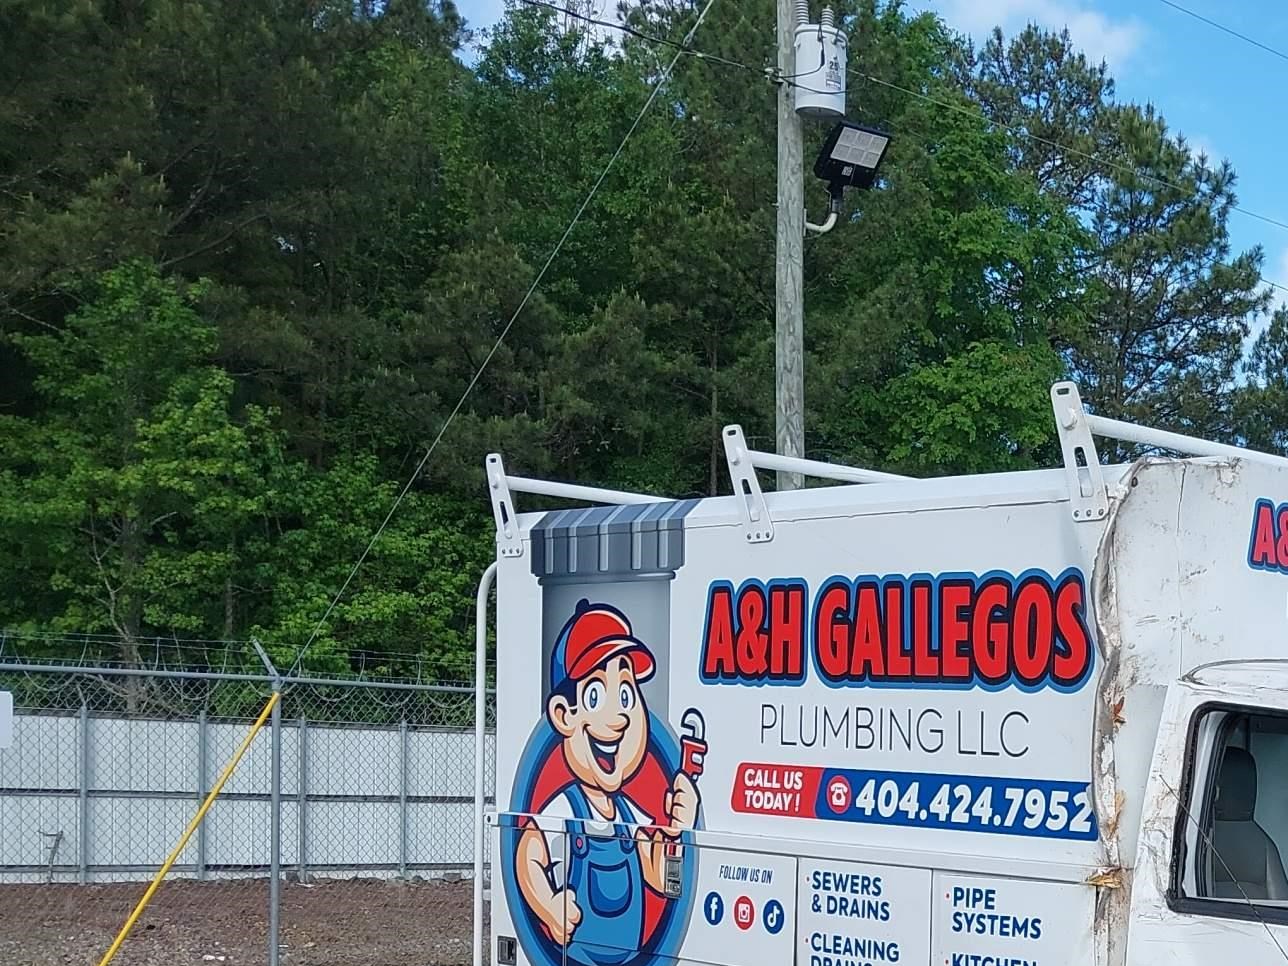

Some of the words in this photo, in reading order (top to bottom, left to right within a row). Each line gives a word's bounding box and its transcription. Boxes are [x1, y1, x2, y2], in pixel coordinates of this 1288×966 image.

[702, 583, 805, 683] A&H
[813, 571, 1094, 690] GALLEGOS
[761, 704, 943, 753] PLUMBING
[958, 710, 1029, 757] LLC
[744, 769, 780, 788] CALL
[784, 771, 803, 790] US
[856, 778, 1093, 833] 404.424.7952
[719, 865, 748, 881] FOLLOW
[750, 868, 760, 882] US
[761, 870, 773, 884] ON
[812, 870, 882, 897] SEWERS
[811, 894, 822, 913] &
[826, 896, 890, 922] DRAINS
[953, 887, 996, 910] PIPE
[952, 912, 1042, 940] SYSTEMS
[810, 933, 900, 962] CLEANING
